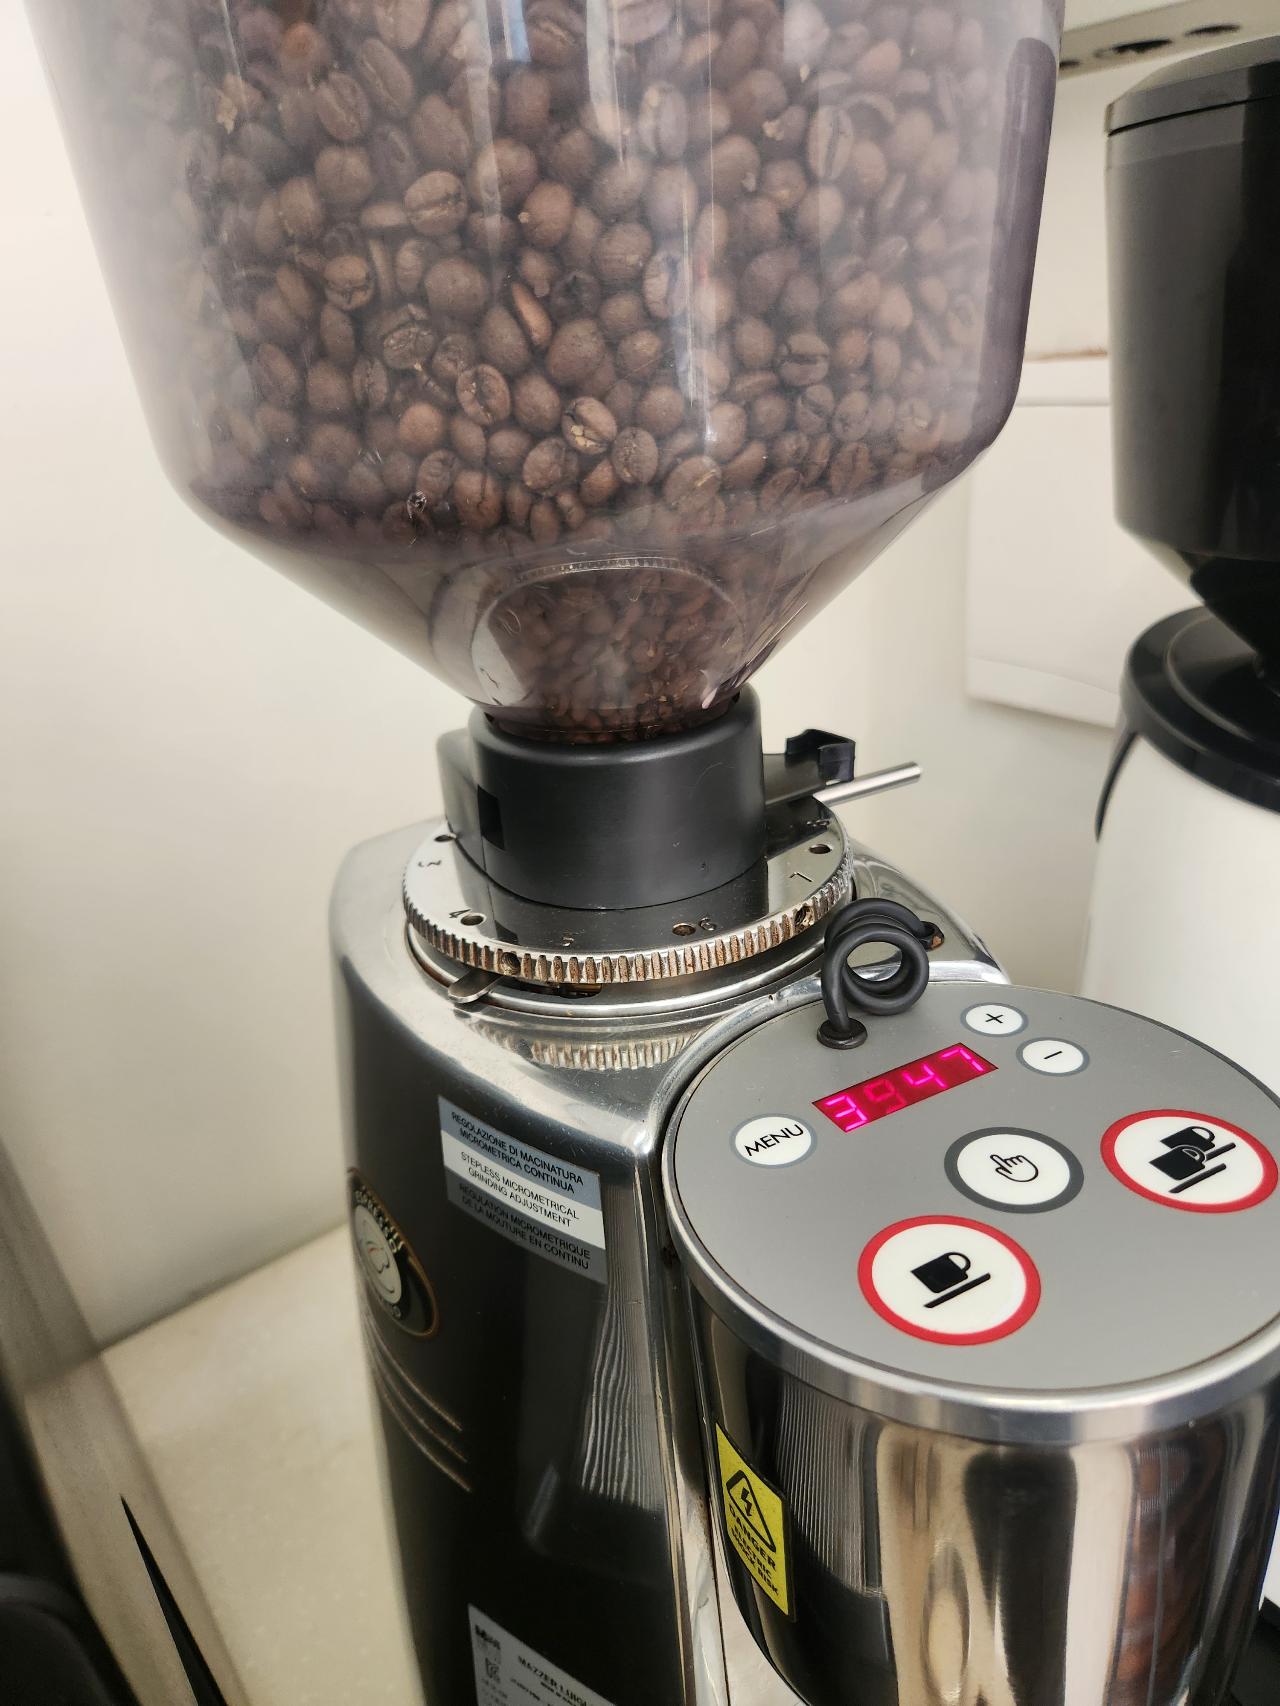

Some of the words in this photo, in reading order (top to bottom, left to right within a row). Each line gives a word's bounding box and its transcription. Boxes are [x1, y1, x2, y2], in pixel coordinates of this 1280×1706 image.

[451, 1111, 507, 1152] REGOLAZIONE
[509, 1146, 518, 1157] DI
[520, 1151, 584, 1185] MACINATURA
[459, 1128, 522, 1172] MICROMETRICA
[524, 1165, 575, 1194] CONTINUA
[745, 1124, 804, 1157] MENU
[461, 1152, 501, 1182] STEPLESS
[502, 1175, 580, 1219] MICROMETRICAL
[468, 1167, 508, 1197] GRINDING
[509, 1191, 572, 1227] ADJUSTMENT
[485, 1209, 526, 1241] MOUTURE
[529, 1235, 542, 1249] EN
[544, 1243, 589, 1270] CONTINU
[510, 1213, 591, 1259] MICROMETRIQUE
[729, 1504, 776, 1571] DANGER
